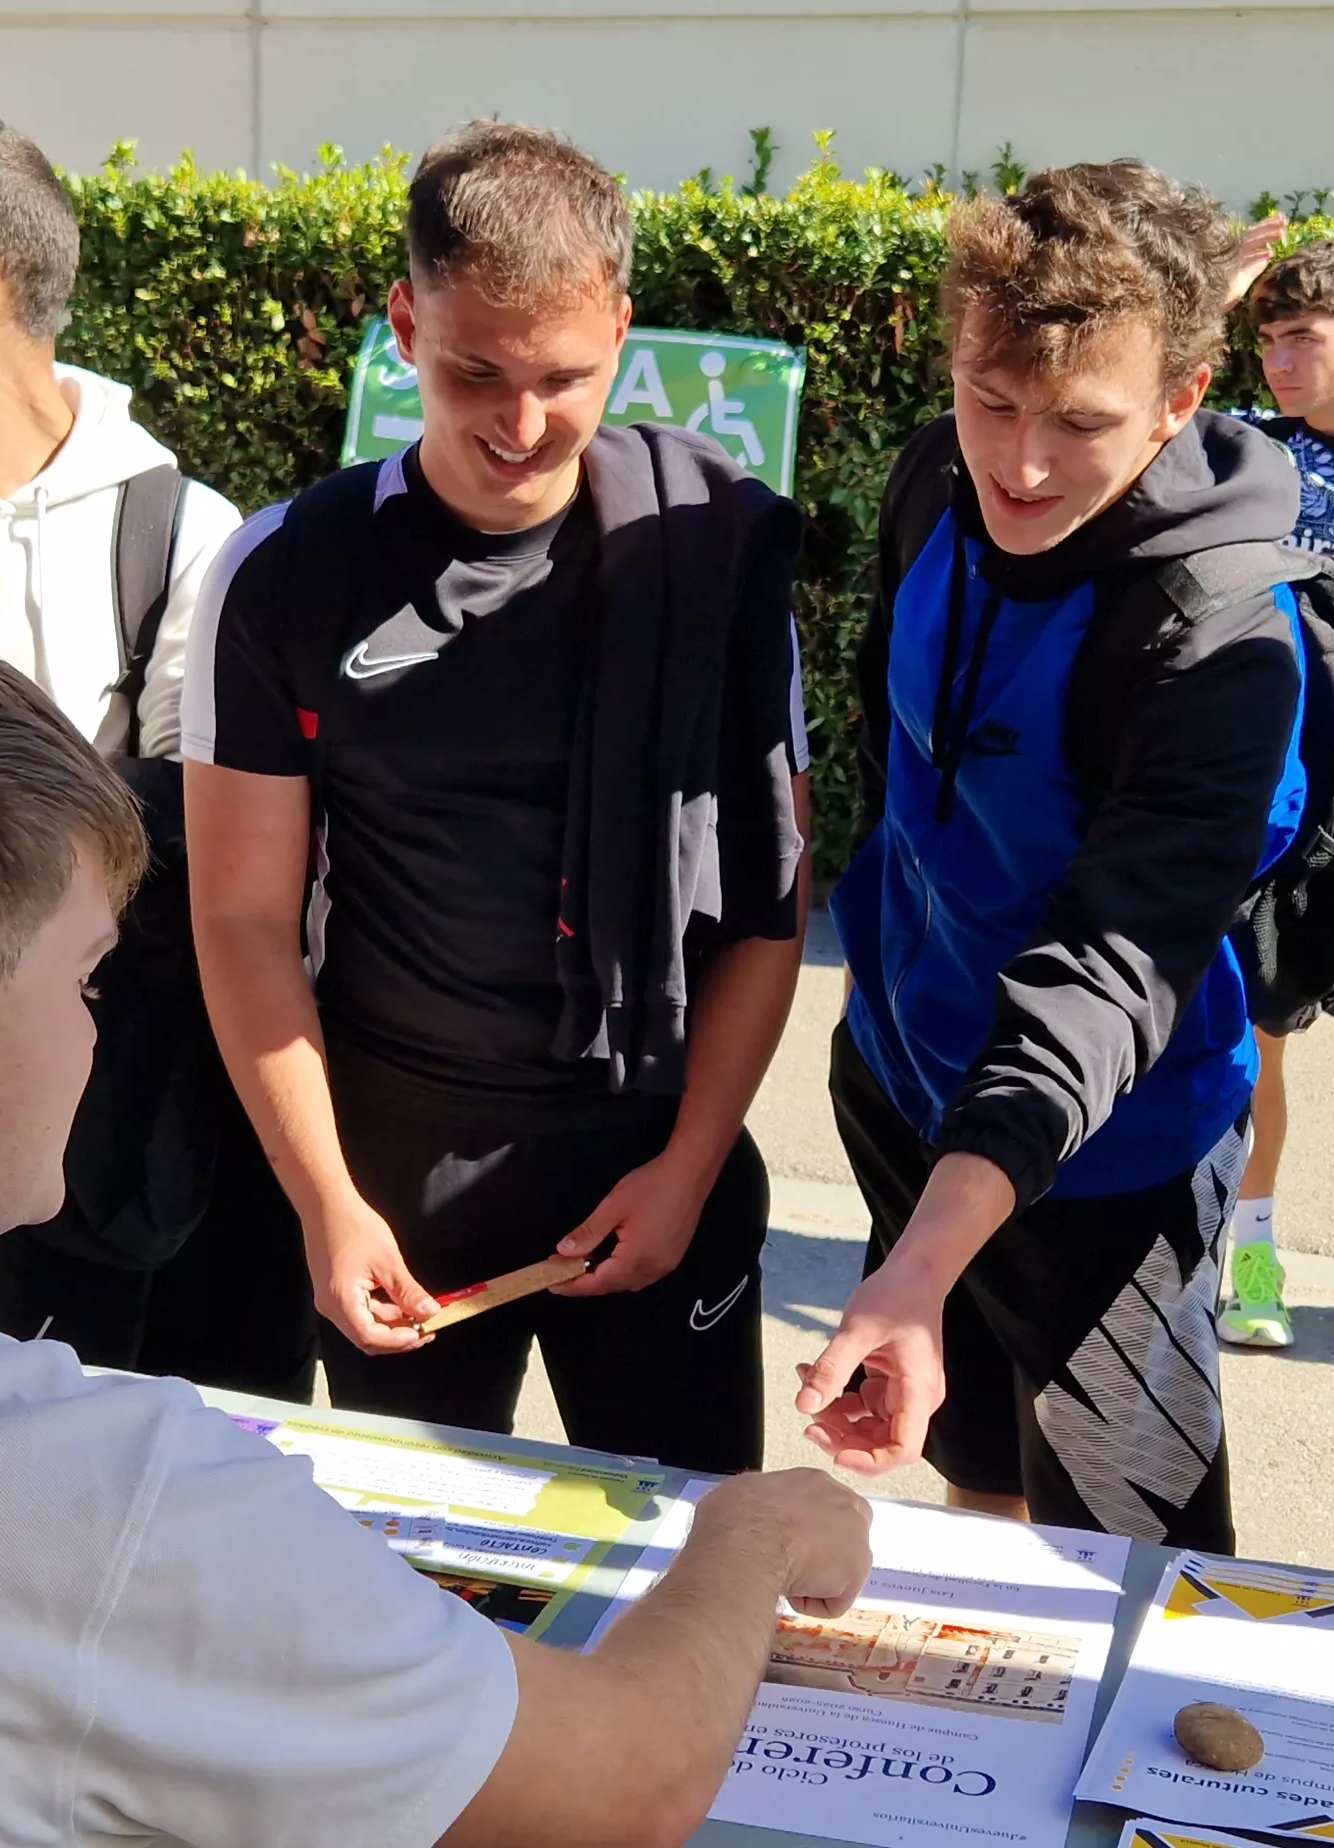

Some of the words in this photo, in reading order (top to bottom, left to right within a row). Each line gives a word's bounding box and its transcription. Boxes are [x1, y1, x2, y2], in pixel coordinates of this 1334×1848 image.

[880, 1582, 929, 1595] jueves
[930, 1590, 956, 1599] Los
[830, 1710, 843, 1718] la
[845, 1712, 861, 1721] de
[909, 1723, 926, 1732] de
[927, 1727, 979, 1741] Campus
[773, 1727, 888, 1753] profesores
[892, 1746, 923, 1760] los
[929, 1753, 955, 1766] de
[761, 1764, 829, 1786] Ciclo
[1146, 1765, 1270, 1797] culturales
[1253, 1769, 1277, 1782] de
[872, 1811, 1028, 1843] #JuevesUniversitarios
